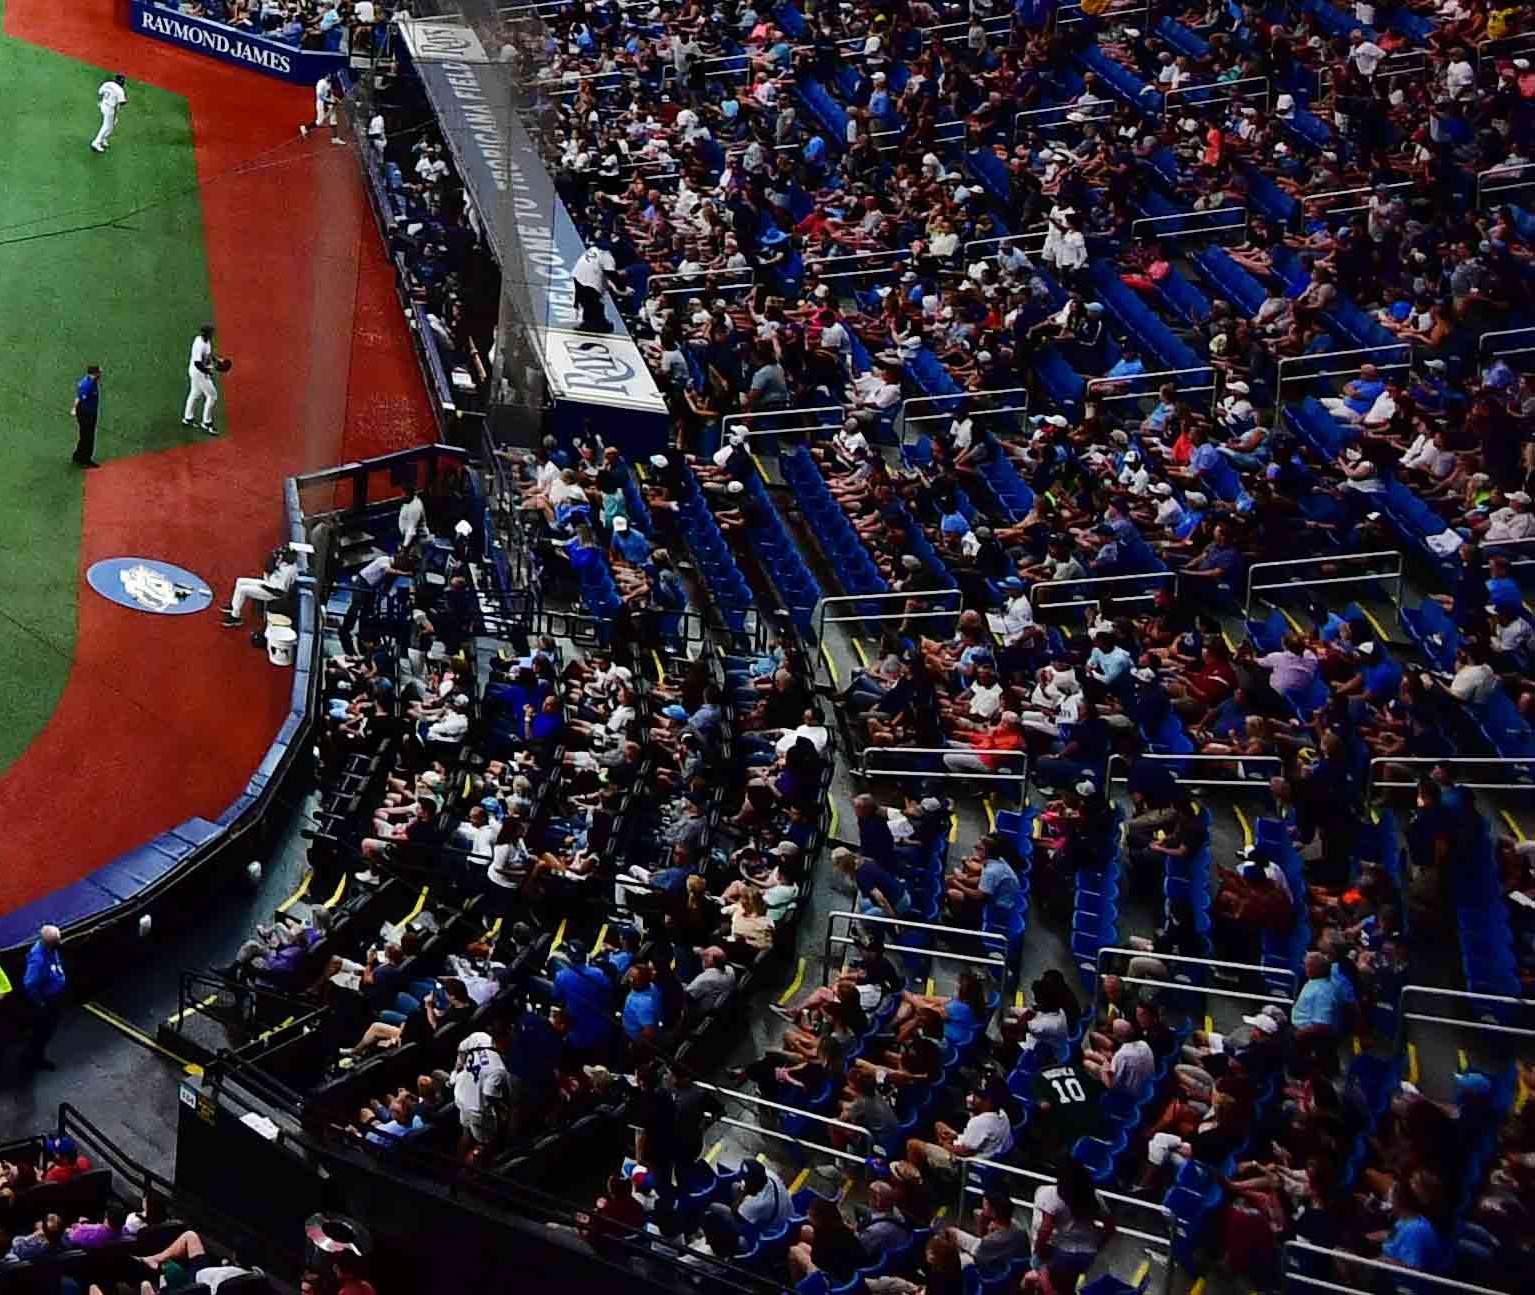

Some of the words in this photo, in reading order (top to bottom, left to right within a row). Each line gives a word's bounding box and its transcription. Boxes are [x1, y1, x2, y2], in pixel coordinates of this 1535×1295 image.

[142, 11, 230, 52] RAYMOND
[230, 38, 290, 73] JAMES
[442, 63, 487, 99] FIELD
[513, 198, 543, 219] TO
[517, 225, 584, 325] WELCOME
[559, 341, 636, 396] RAYS
[1052, 1078, 1086, 1104] 10
